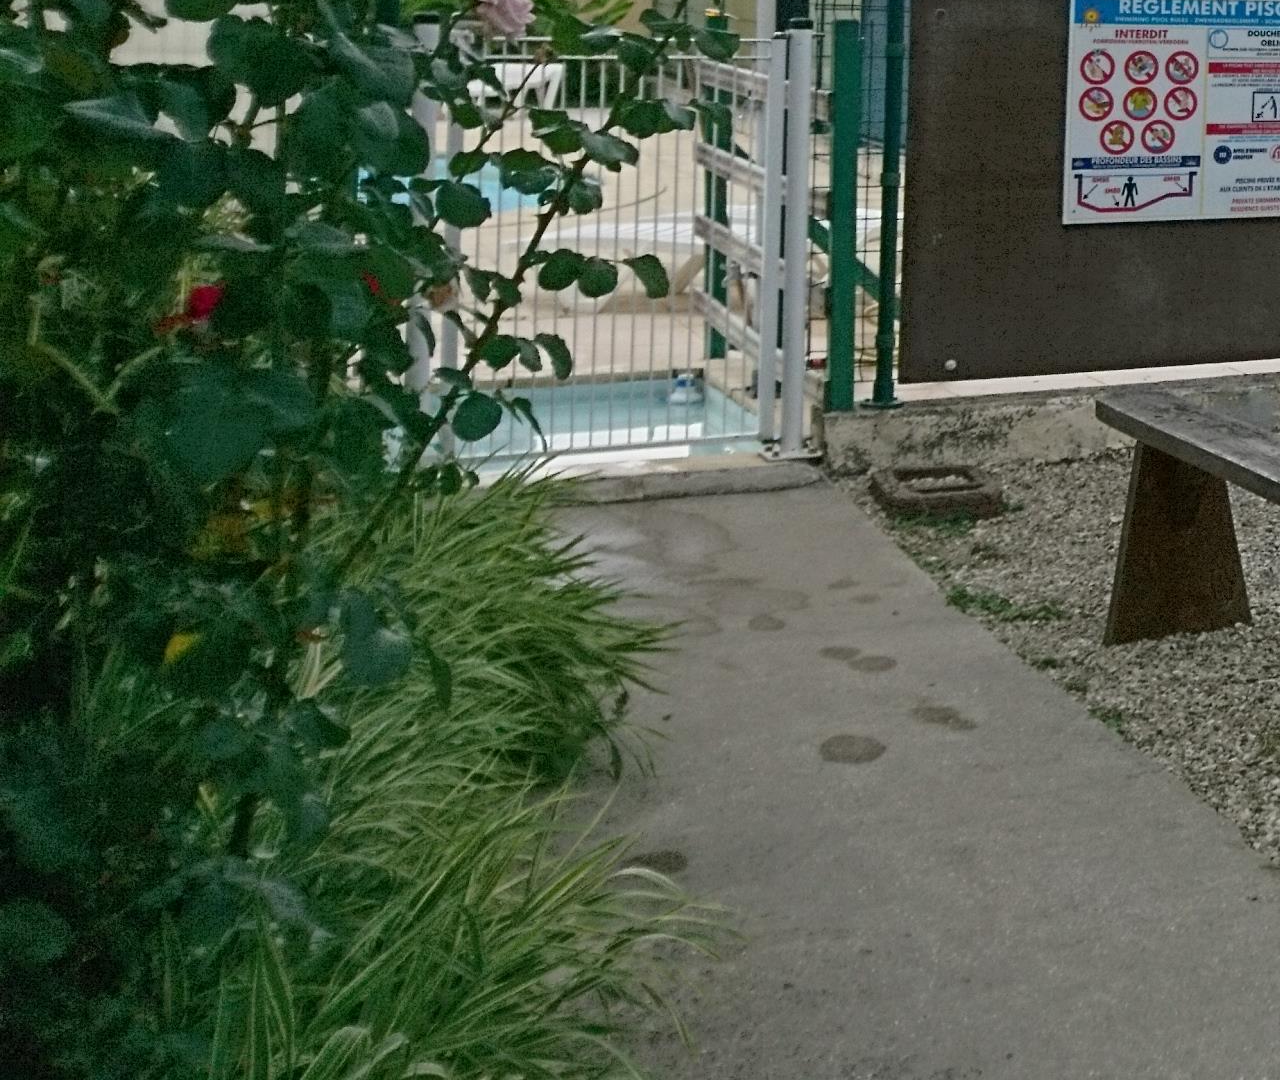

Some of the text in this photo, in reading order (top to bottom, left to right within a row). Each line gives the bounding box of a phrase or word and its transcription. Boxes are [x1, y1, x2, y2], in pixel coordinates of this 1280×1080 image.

[1120, 0, 1239, 16] REGLEMENT
[1115, 29, 1168, 38] INTERDIT
[1092, 157, 1137, 165] PROFONDEUR
[1140, 156, 1154, 164] DES
